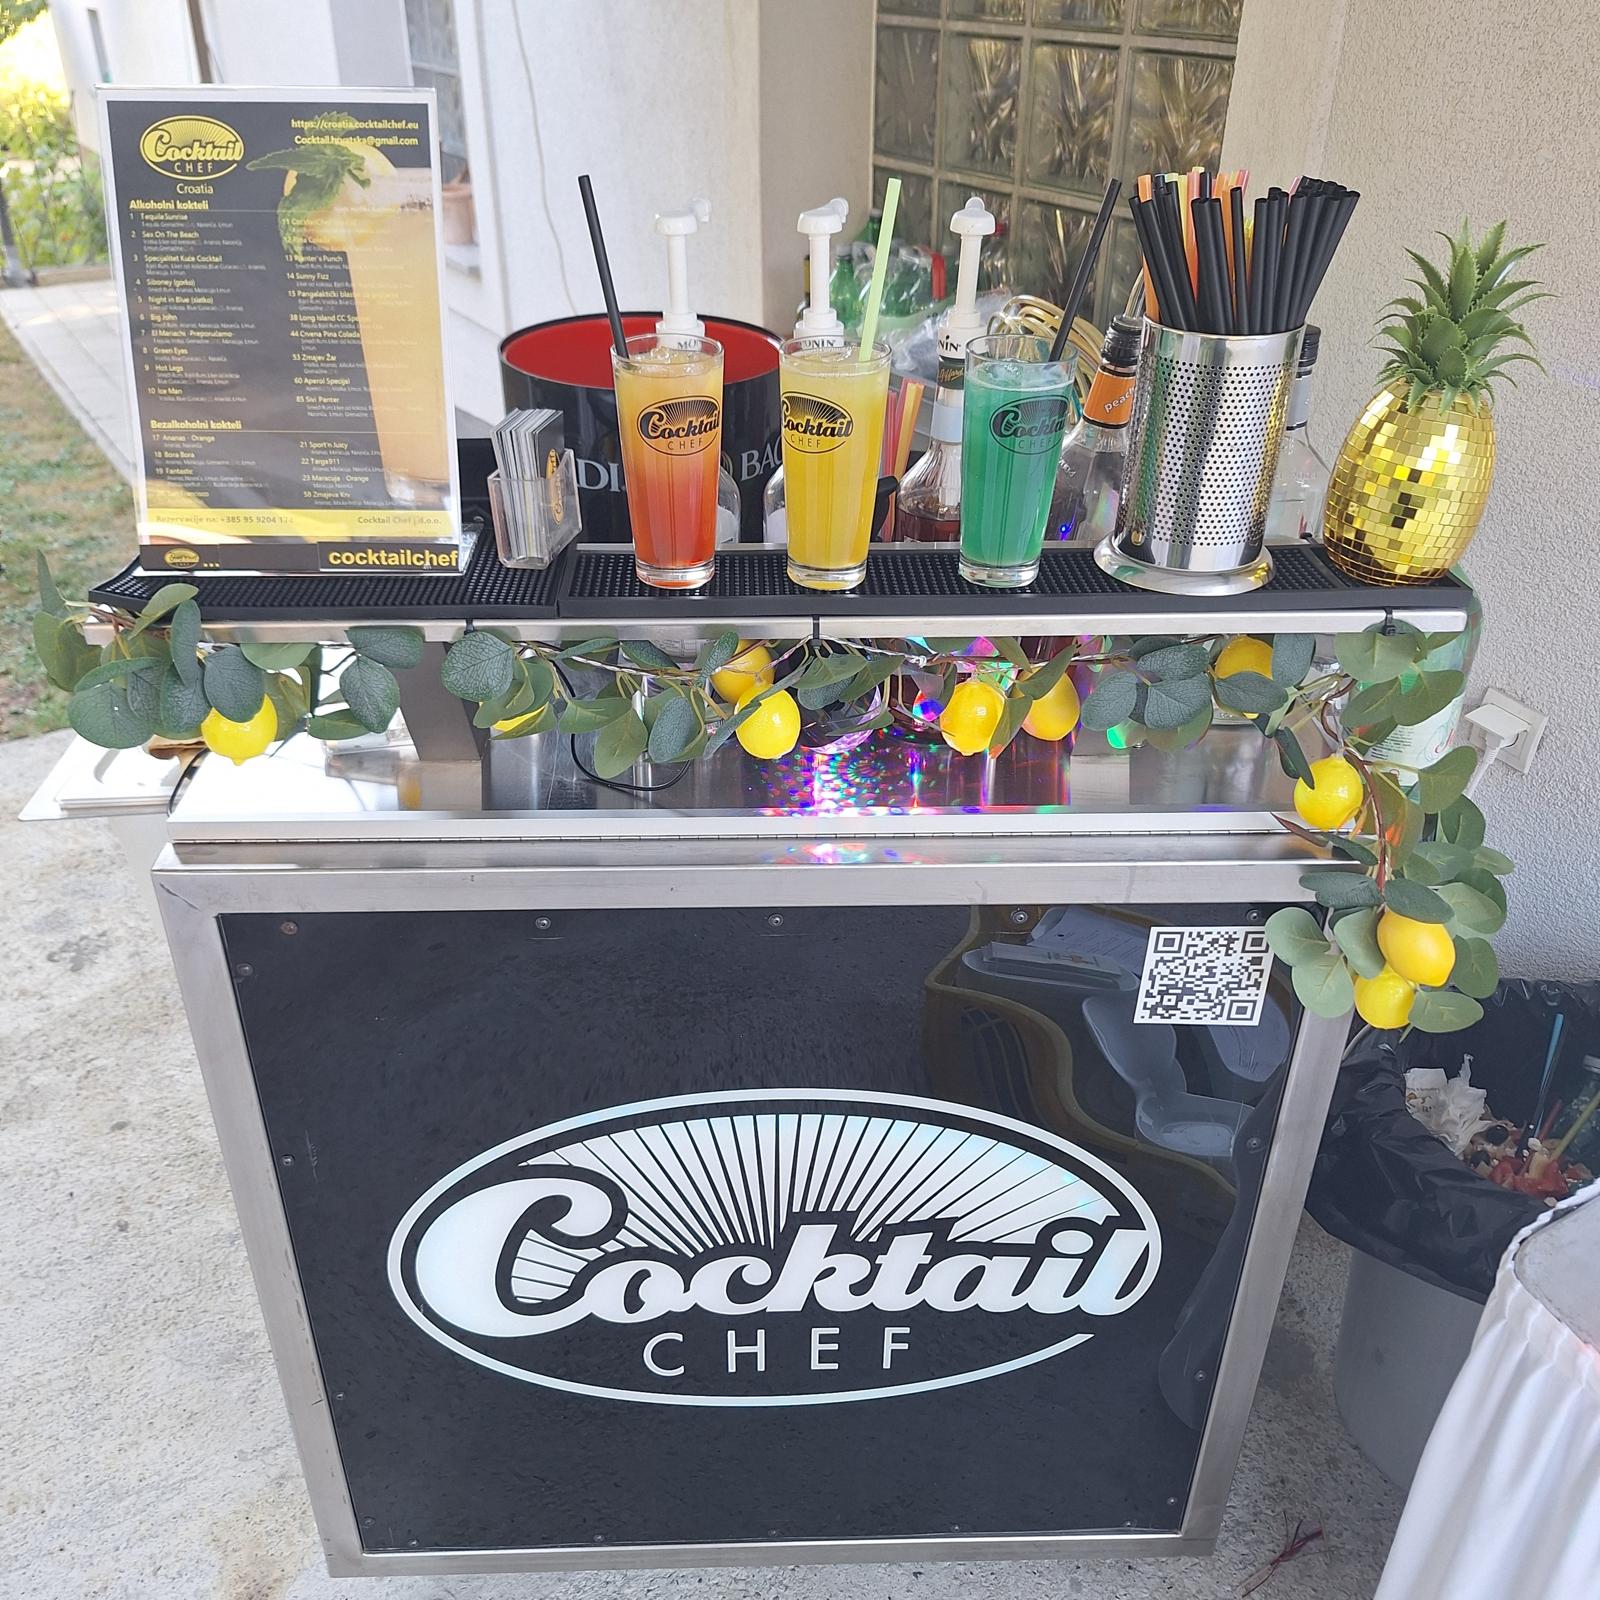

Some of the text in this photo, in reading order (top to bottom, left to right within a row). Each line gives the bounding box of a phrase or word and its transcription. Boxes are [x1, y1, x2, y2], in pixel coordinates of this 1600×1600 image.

[291, 119, 418, 131] https://croatia.cocktailchef.eu
[143, 128, 242, 162] Cocktail
[174, 162, 213, 173] CHEF
[176, 183, 214, 194] Croatia
[130, 200, 209, 210] Alkoholni kokteli
[323, 254, 343, 262] Punch
[299, 315, 315, 323] Long
[803, 338, 836, 349] ONIN
[304, 378, 325, 386] Aperol
[150, 419, 242, 430] Bezalkoholni kokteli
[191, 434, 215, 443] Orange
[667, 438, 703, 450] CHEF
[790, 433, 821, 448] CHEF
[1018, 439, 1052, 449] CHEF
[345, 475, 369, 483] Orange
[357, 516, 390, 524] Cocktail
[328, 549, 457, 567] cocktailchef
[415, 1177, 1153, 1338] Cocktail
[642, 1326, 911, 1376] CHEF
